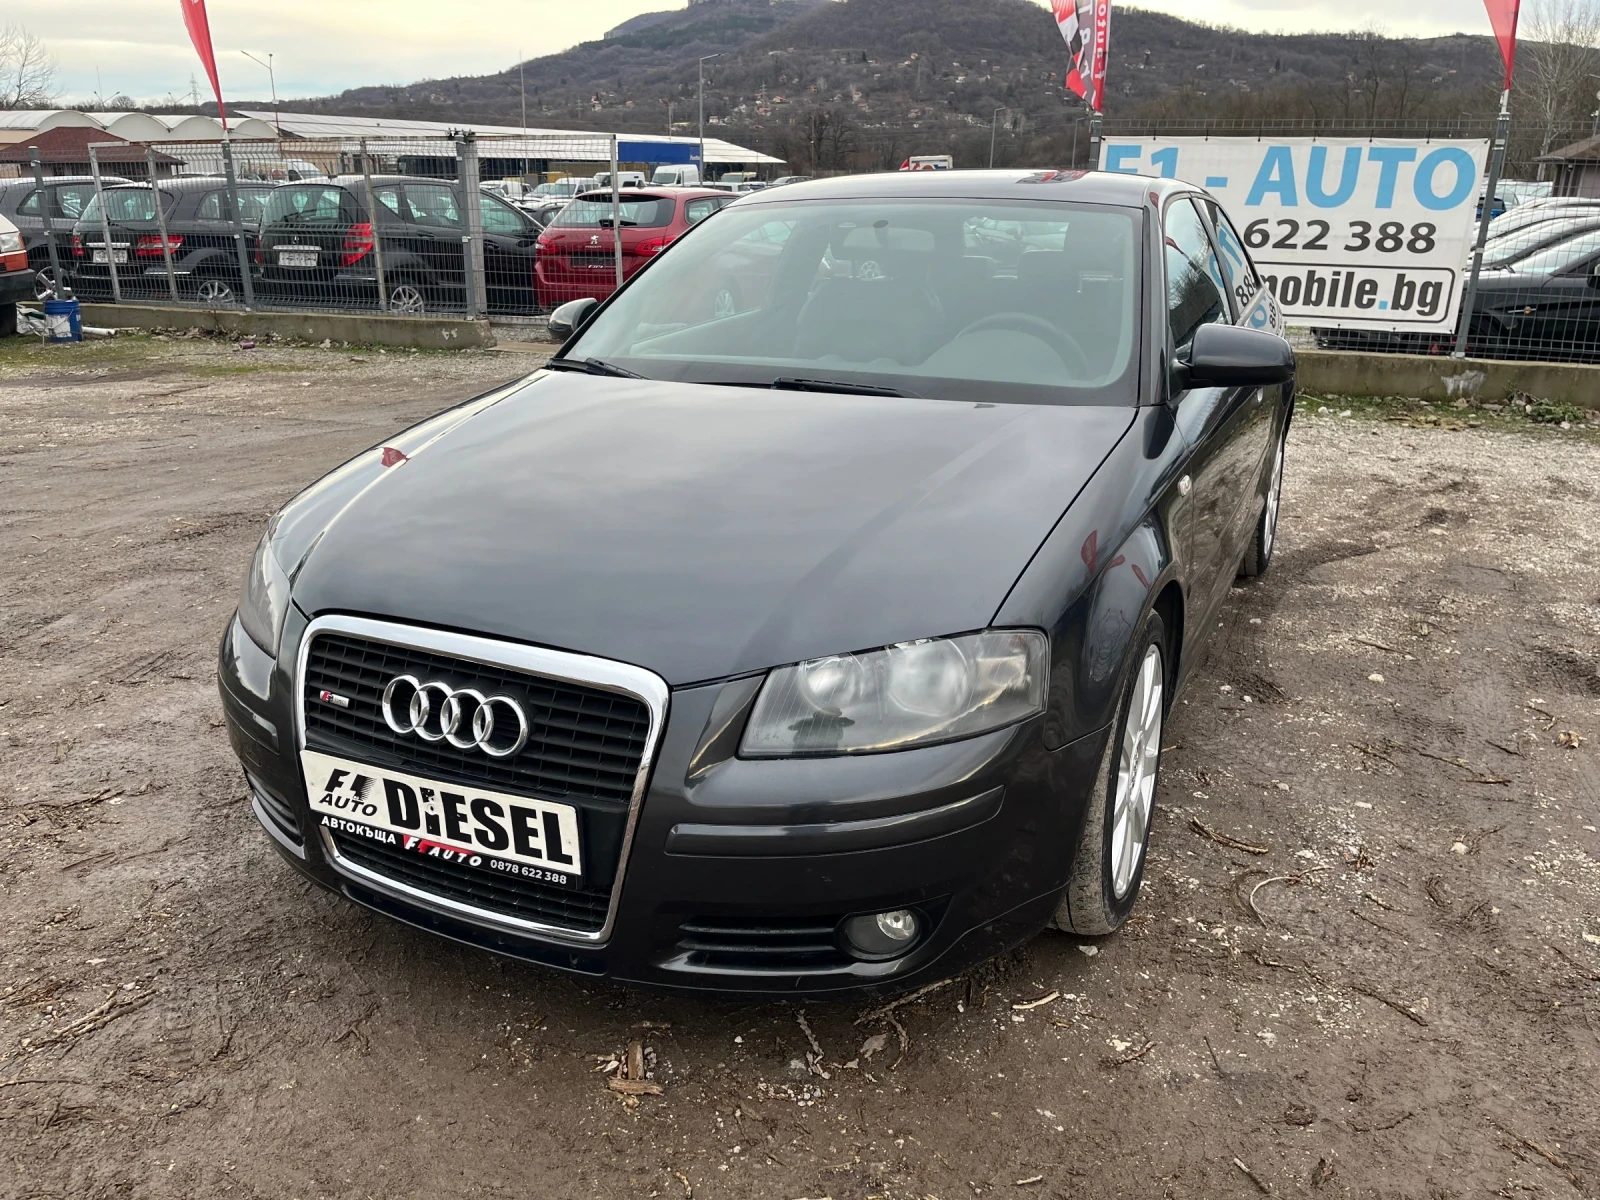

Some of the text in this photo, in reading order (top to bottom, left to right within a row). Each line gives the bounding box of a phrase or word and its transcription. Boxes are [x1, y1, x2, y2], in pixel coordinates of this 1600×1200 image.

[1205, 176, 1228, 188] -
[1244, 146, 1476, 211] AUTO
[1244, 218, 1436, 254] 622 388
[325, 768, 376, 801] F1
[319, 793, 378, 816] AUTO
[321, 815, 397, 845] АВТОКЪЩА
[428, 846, 482, 867] AUTO
[490, 859, 519, 874] 0878
[521, 867, 543, 879] 622
[544, 871, 567, 885] 388
